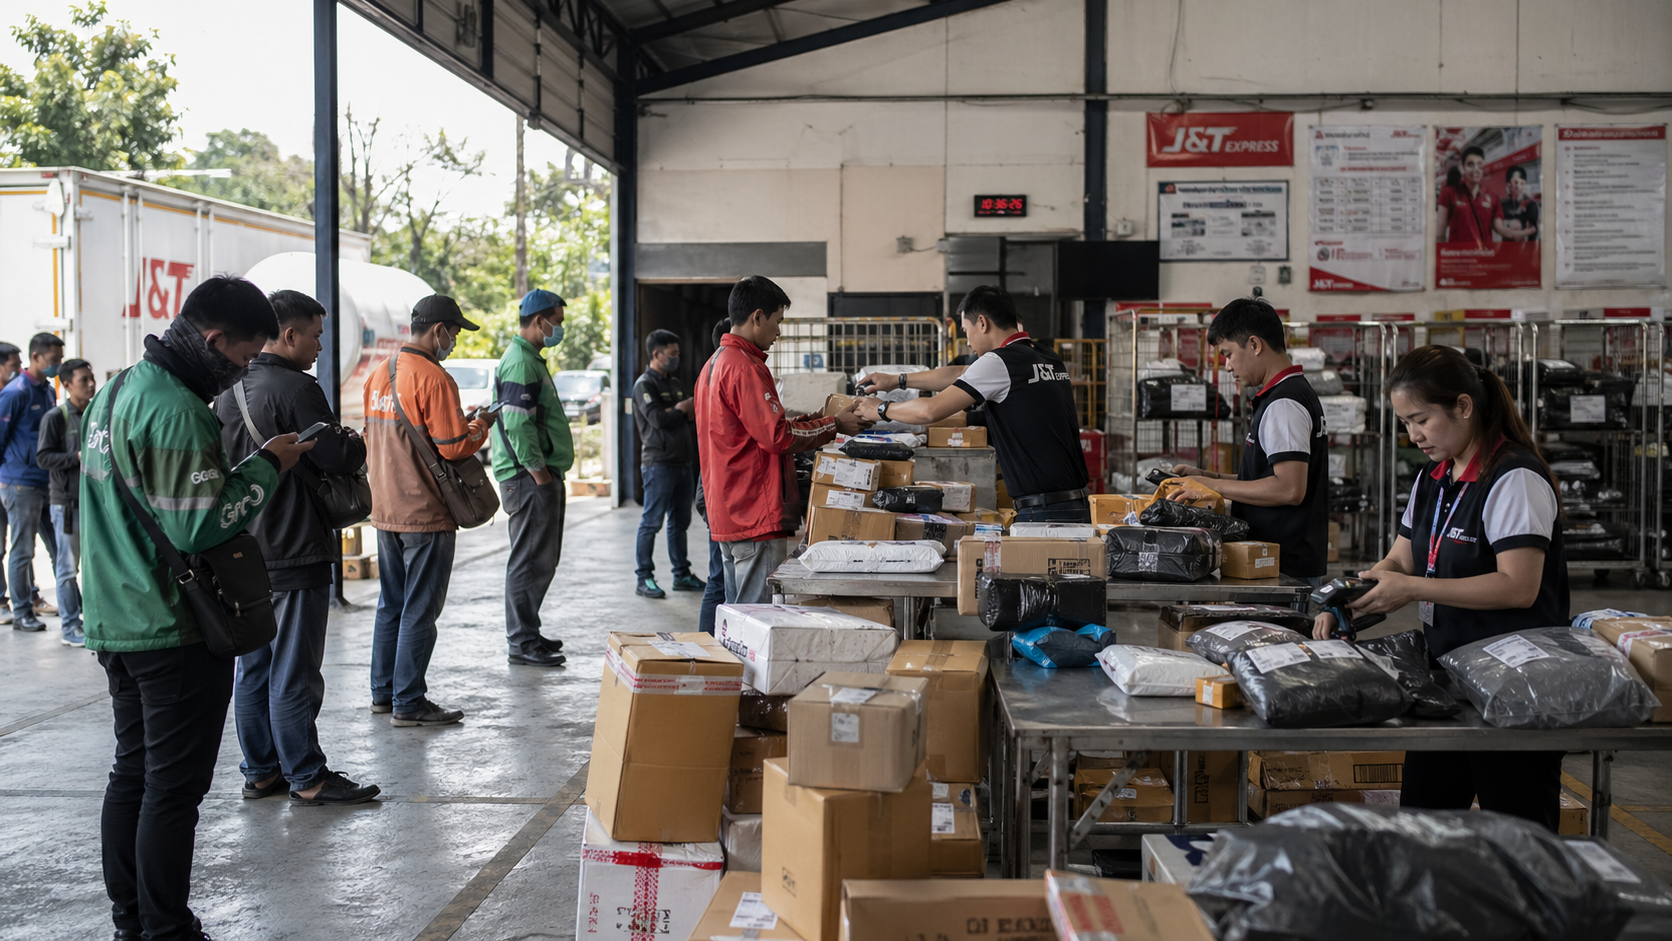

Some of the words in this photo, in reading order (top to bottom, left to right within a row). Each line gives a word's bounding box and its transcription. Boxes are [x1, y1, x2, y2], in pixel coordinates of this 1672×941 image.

[1161, 126, 1238, 153] J&T
[1223, 140, 1280, 153] EXPRESS
[122, 256, 195, 320] J&T
[1028, 363, 1055, 384] J&T
